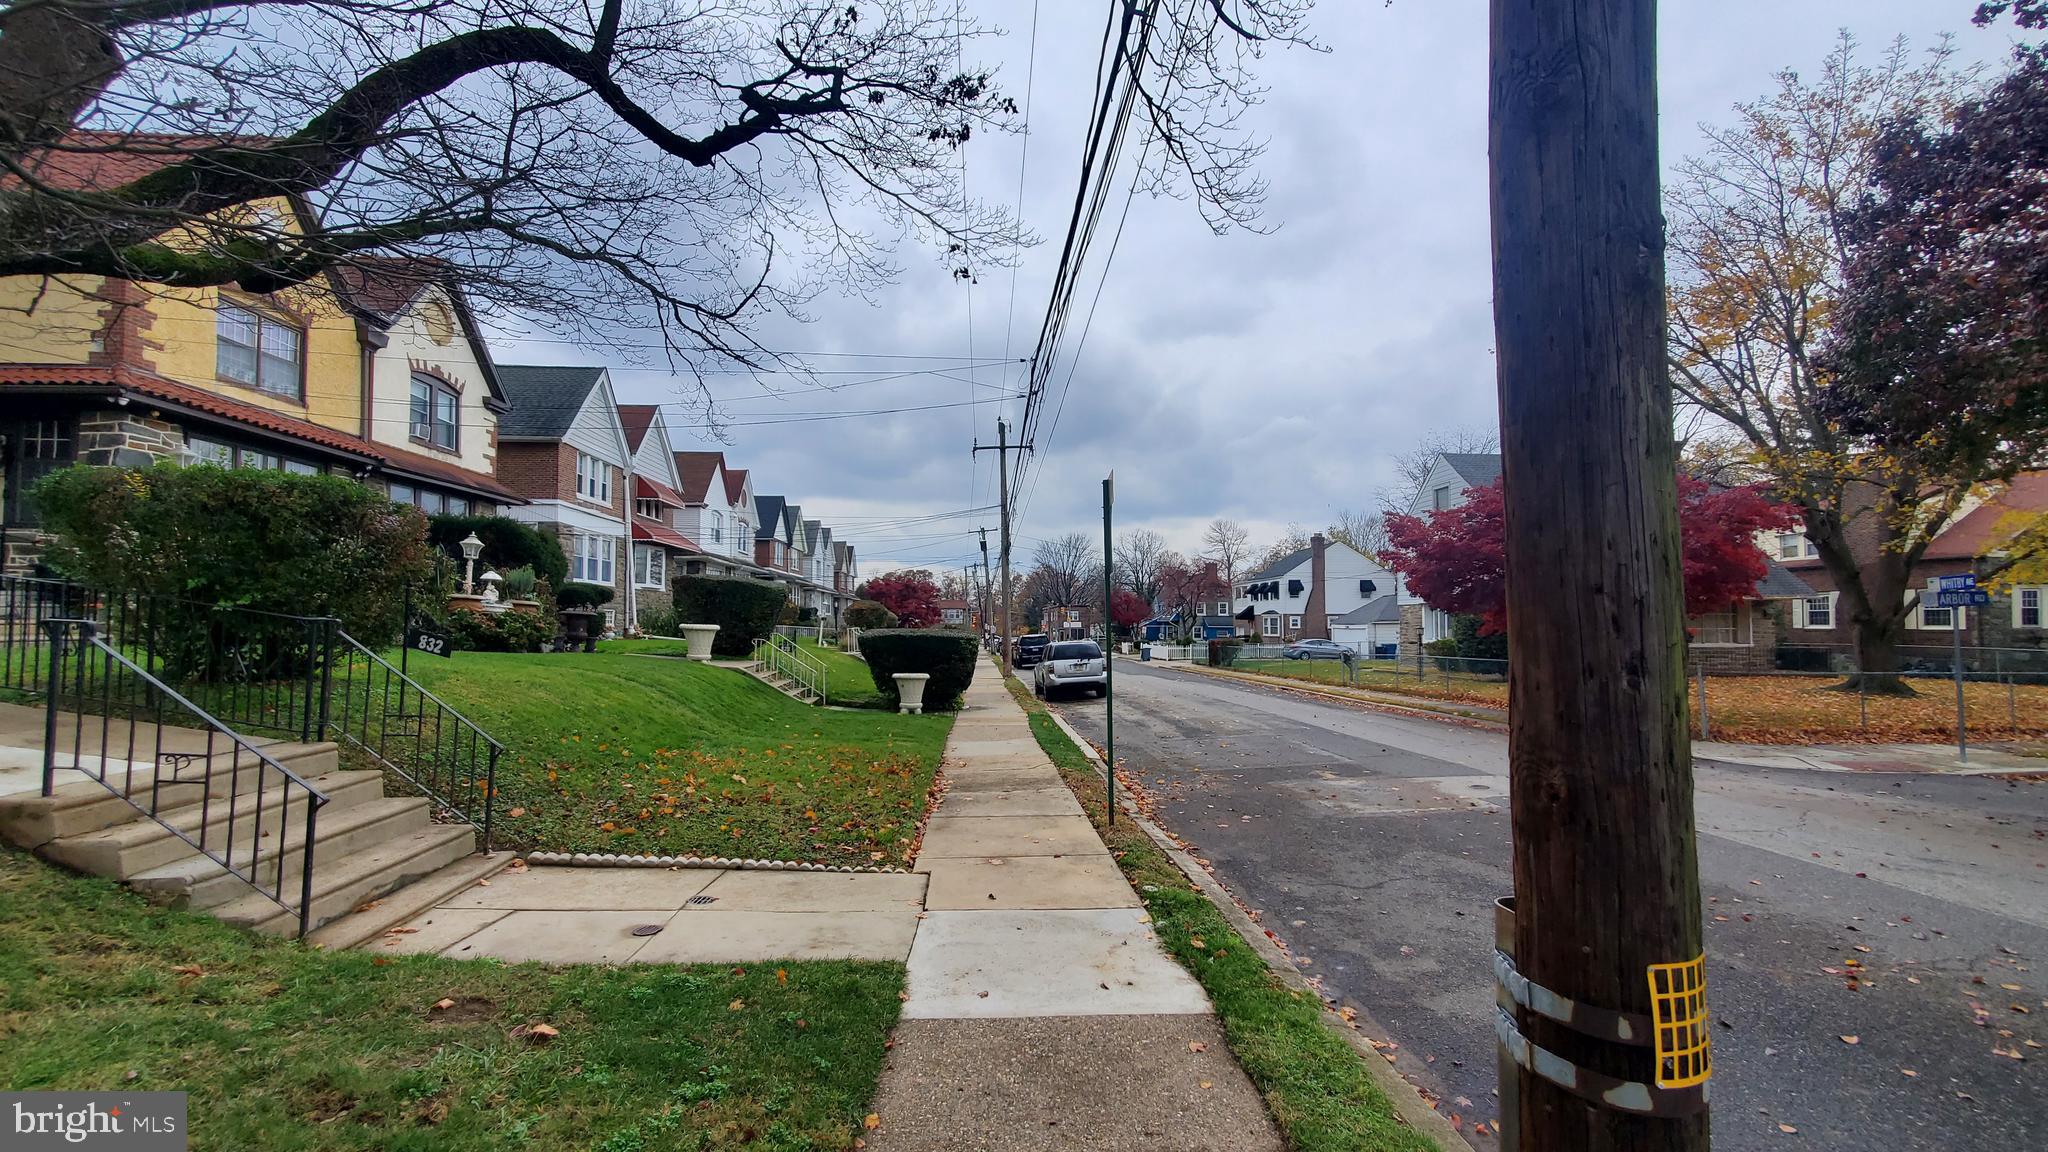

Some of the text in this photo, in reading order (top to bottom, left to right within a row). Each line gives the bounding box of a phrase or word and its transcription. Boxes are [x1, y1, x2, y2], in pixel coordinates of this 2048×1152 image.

[1940, 577, 1965, 589] WHITBY
[1940, 593, 1971, 605] ARBOR
[418, 635, 444, 654] 832
